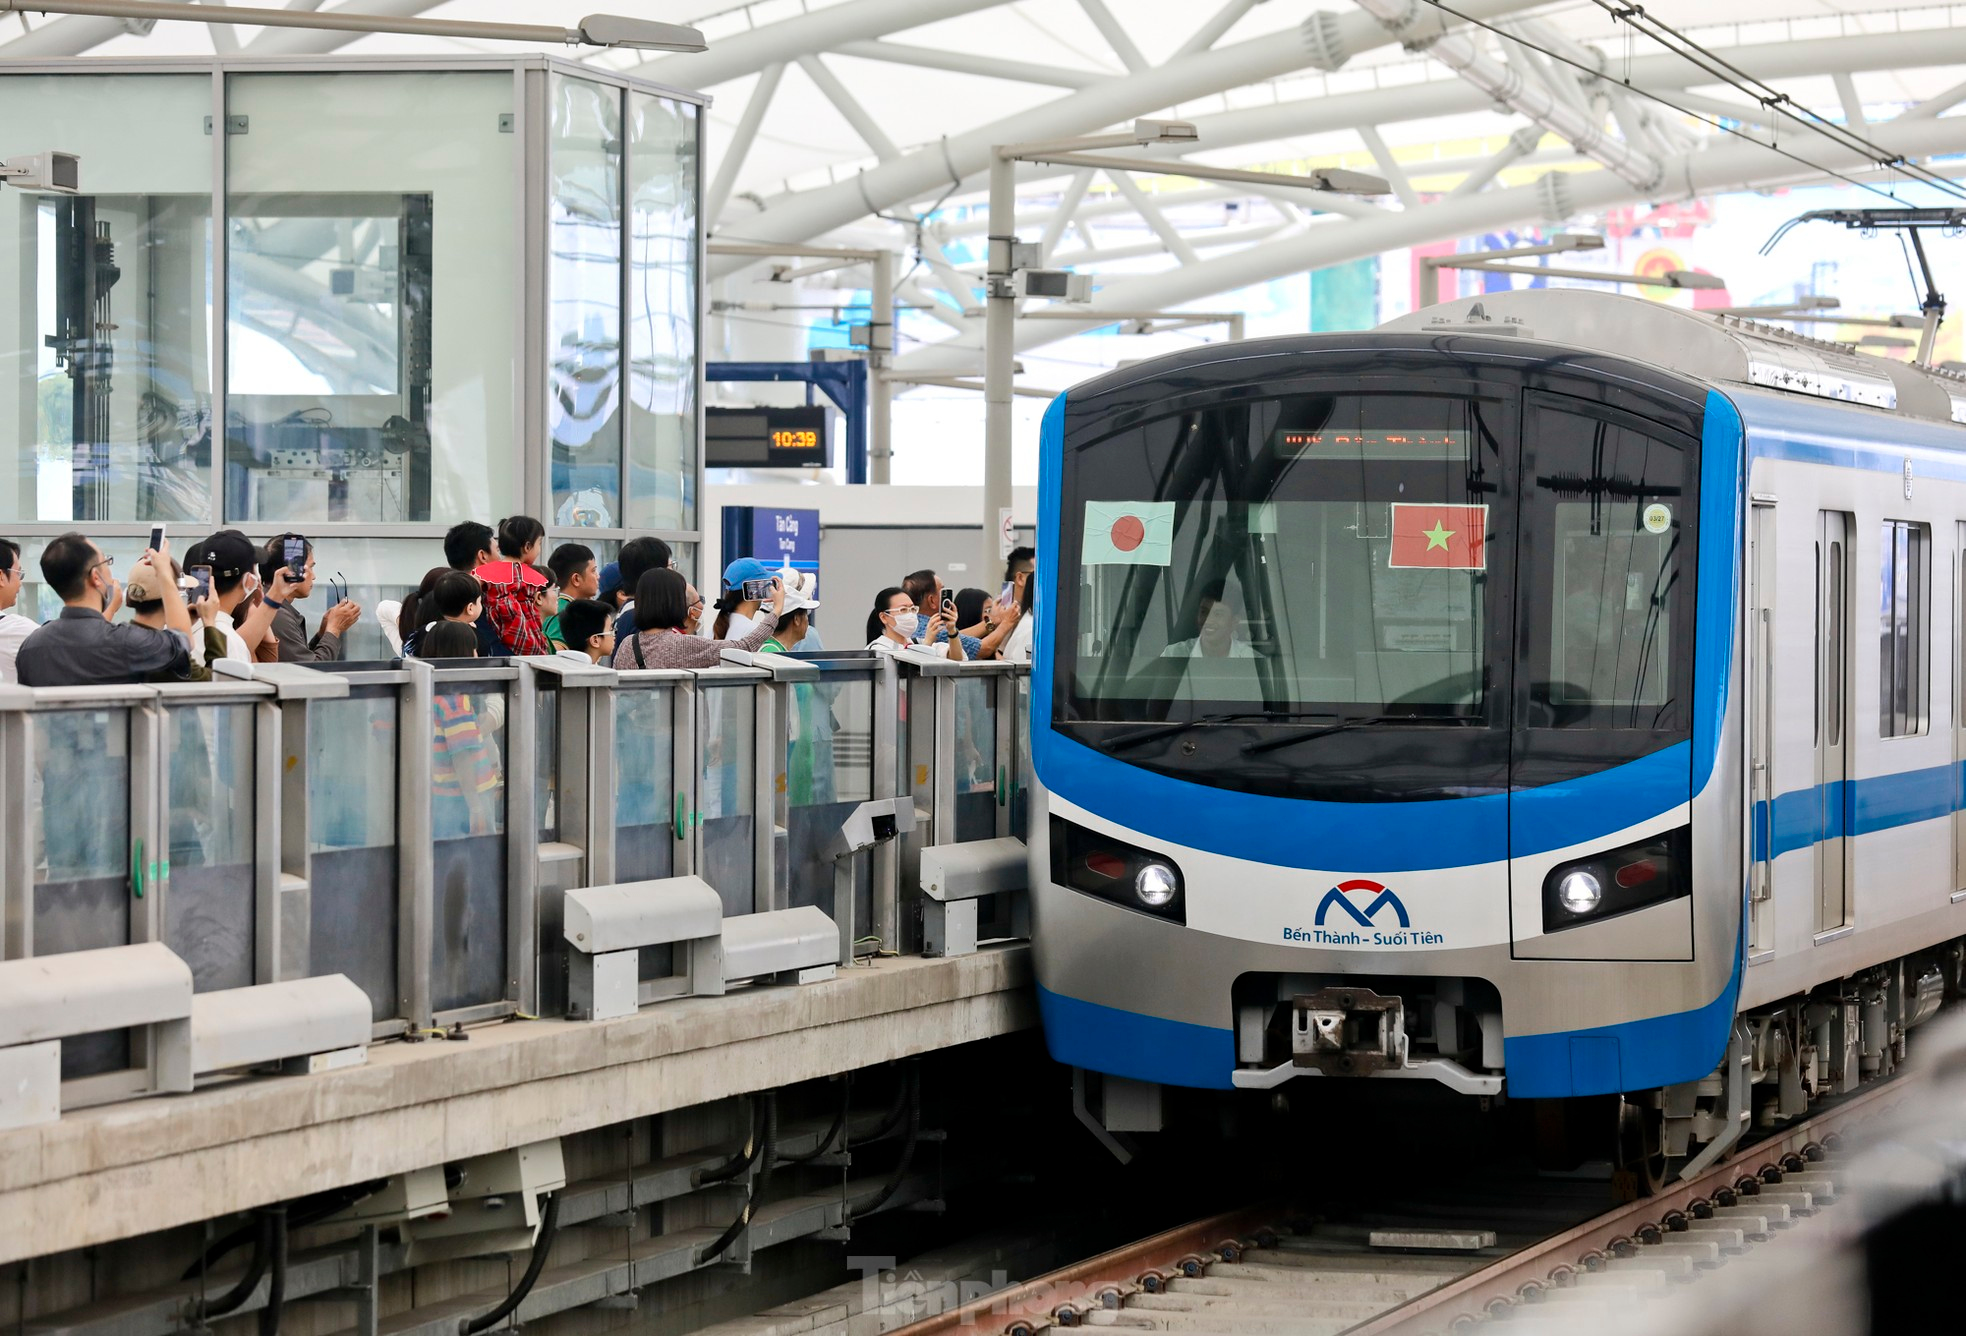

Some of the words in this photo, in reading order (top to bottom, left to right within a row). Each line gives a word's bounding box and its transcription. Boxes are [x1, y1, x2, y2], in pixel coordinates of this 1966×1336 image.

[1283, 927, 1311, 943] Bến
[1313, 930, 1360, 945] Thành
[1374, 928, 1407, 946] Suối
[1410, 931, 1443, 945] Tiên
